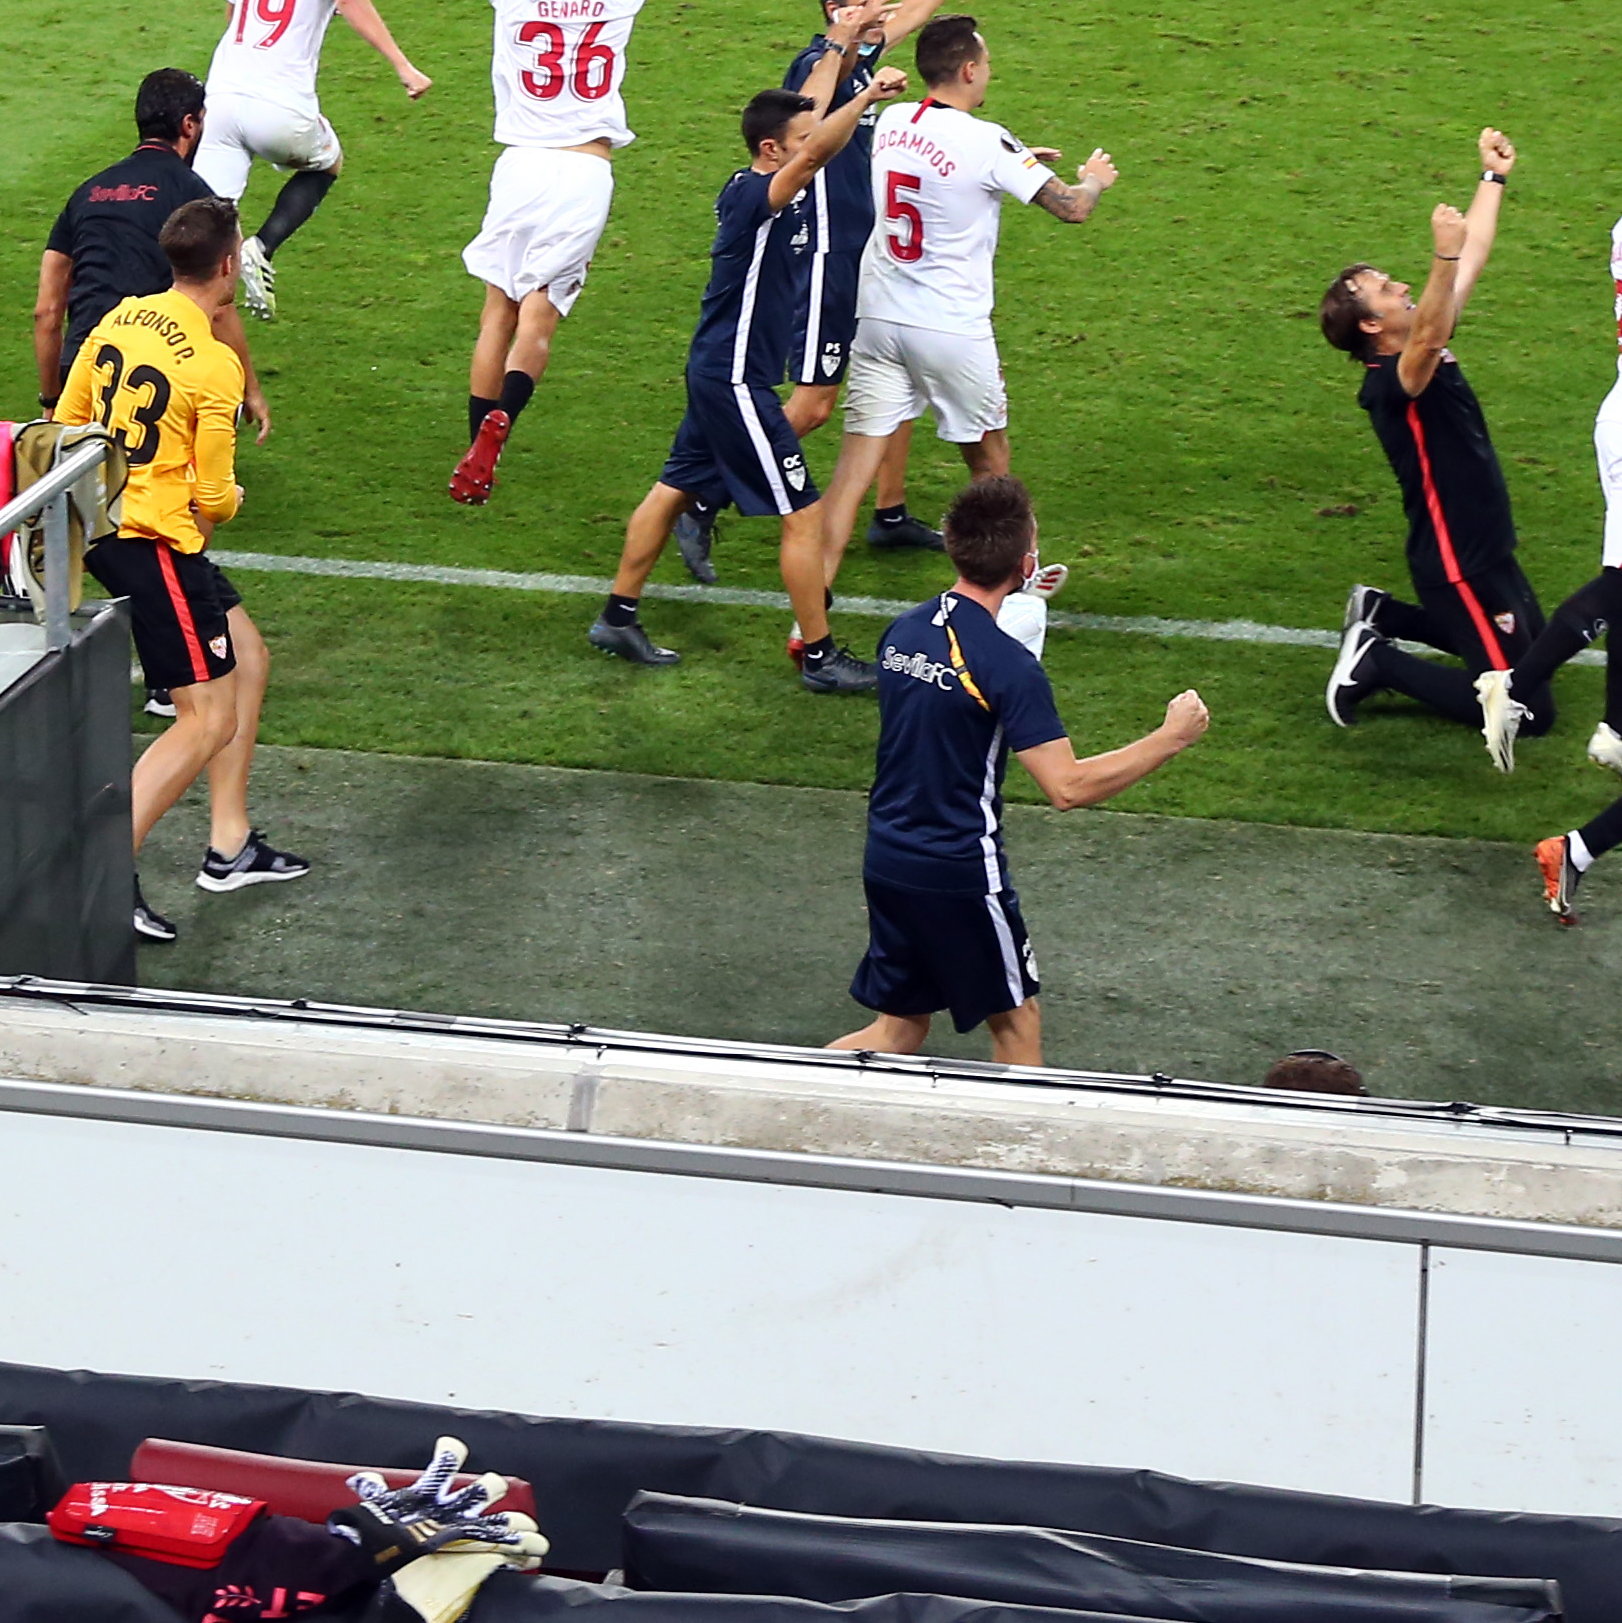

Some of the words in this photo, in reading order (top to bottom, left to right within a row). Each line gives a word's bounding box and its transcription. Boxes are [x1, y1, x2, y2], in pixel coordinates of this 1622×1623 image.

[513, 21, 615, 102] 36
[884, 170, 925, 264] 5
[111, 308, 187, 348] ALFONSO
[89, 343, 172, 467] 33
